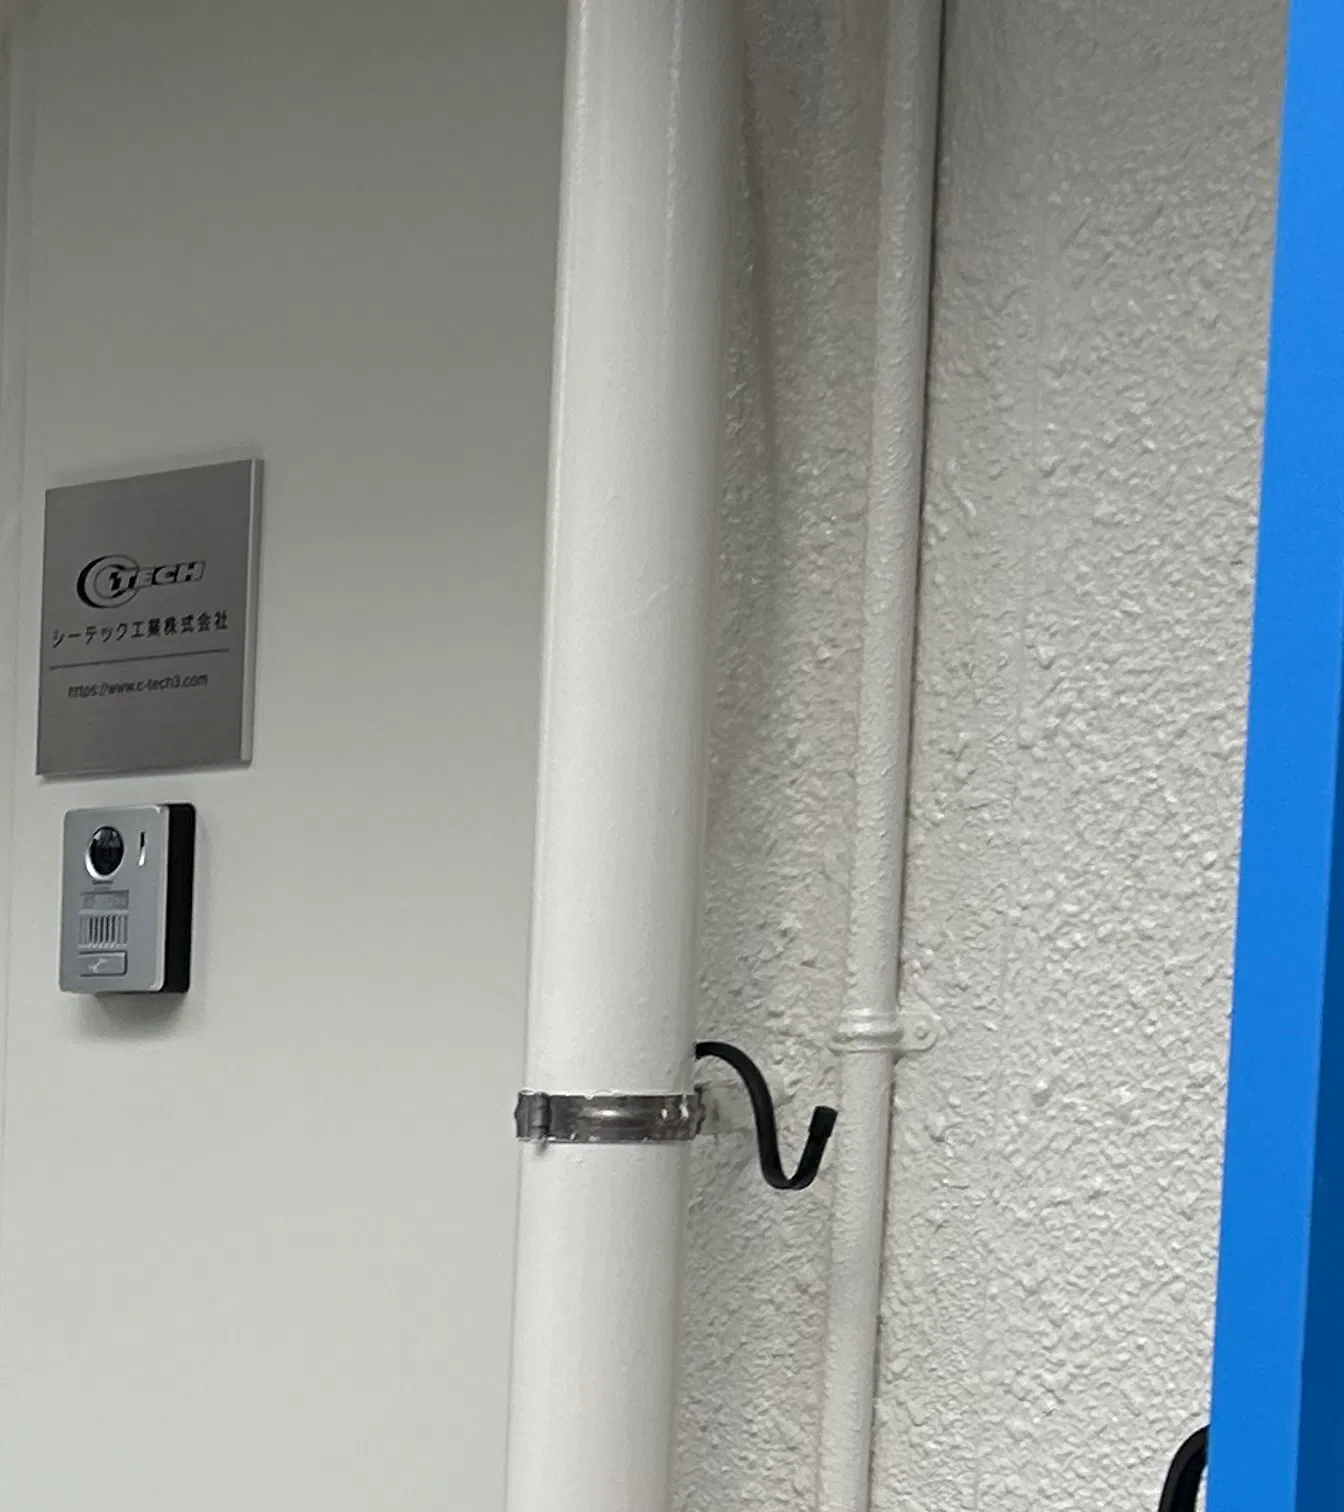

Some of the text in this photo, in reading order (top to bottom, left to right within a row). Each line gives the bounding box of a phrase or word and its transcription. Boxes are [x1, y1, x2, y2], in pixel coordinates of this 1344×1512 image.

[51, 609, 229, 649] シーテック工業株式会社
